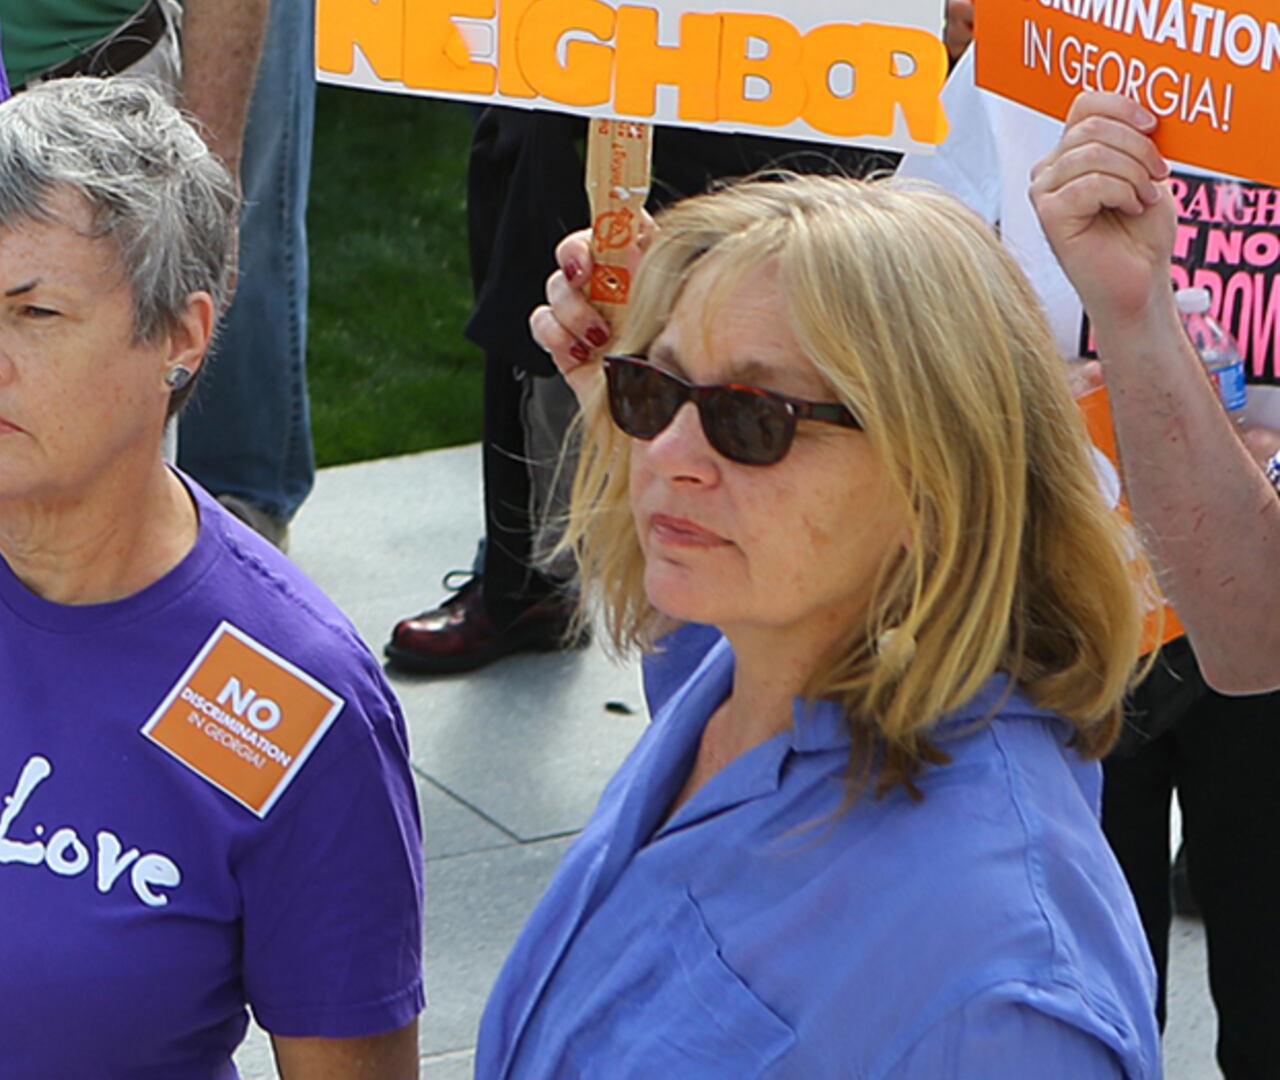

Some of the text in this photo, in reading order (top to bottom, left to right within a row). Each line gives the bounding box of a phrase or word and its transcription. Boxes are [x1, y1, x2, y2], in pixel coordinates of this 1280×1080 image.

[1023, 19, 1234, 133] IN GEORGIA!
[180, 686, 293, 767] DISCRIMINATION
[215, 676, 281, 731] NO
